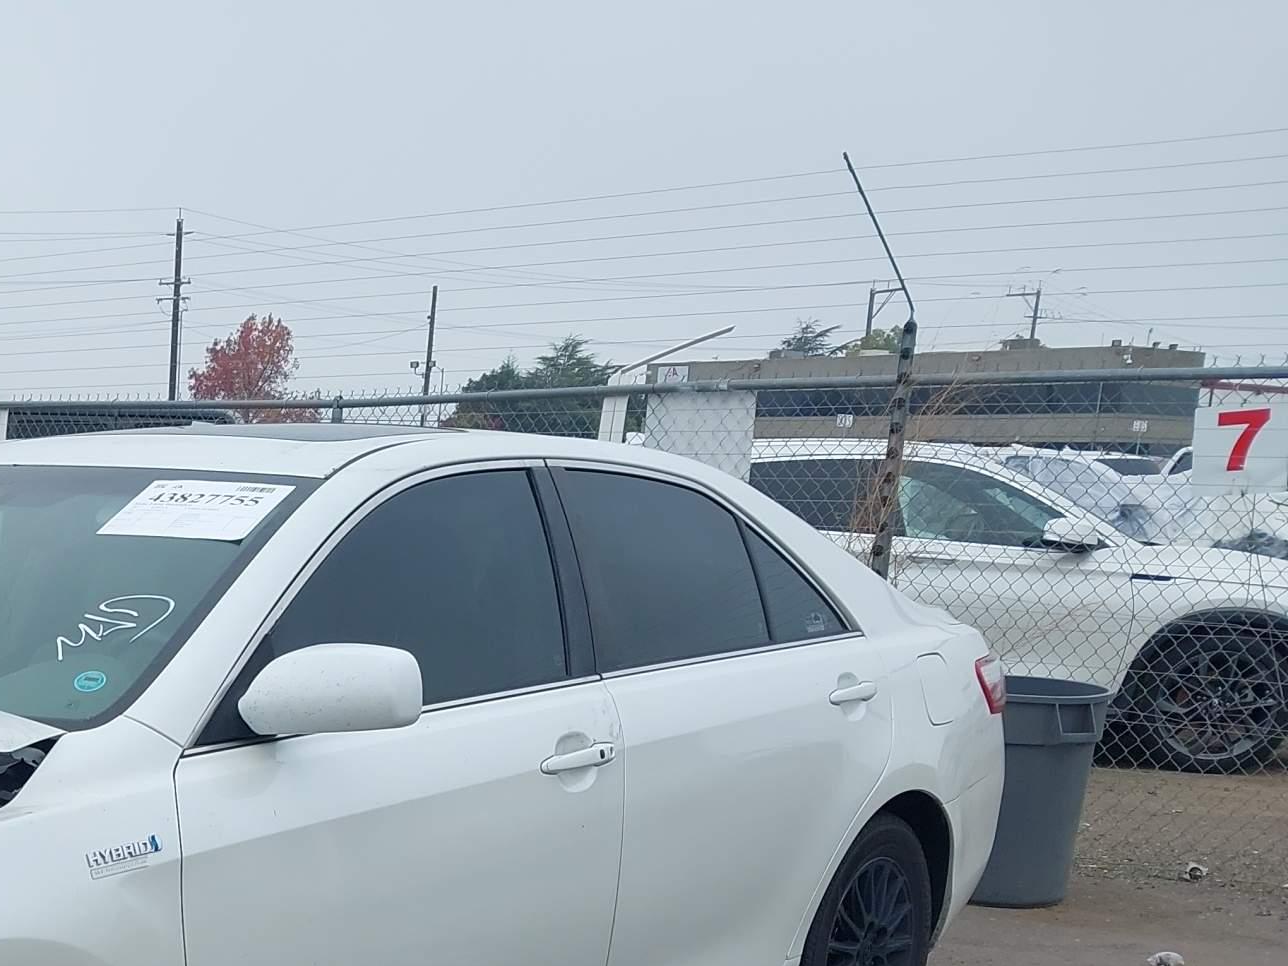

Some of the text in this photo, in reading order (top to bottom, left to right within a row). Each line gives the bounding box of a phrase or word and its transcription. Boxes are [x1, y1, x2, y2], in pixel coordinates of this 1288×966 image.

[1217, 408, 1271, 472] 7
[149, 491, 265, 507] 43827755
[85, 841, 151, 868] HYBRID
